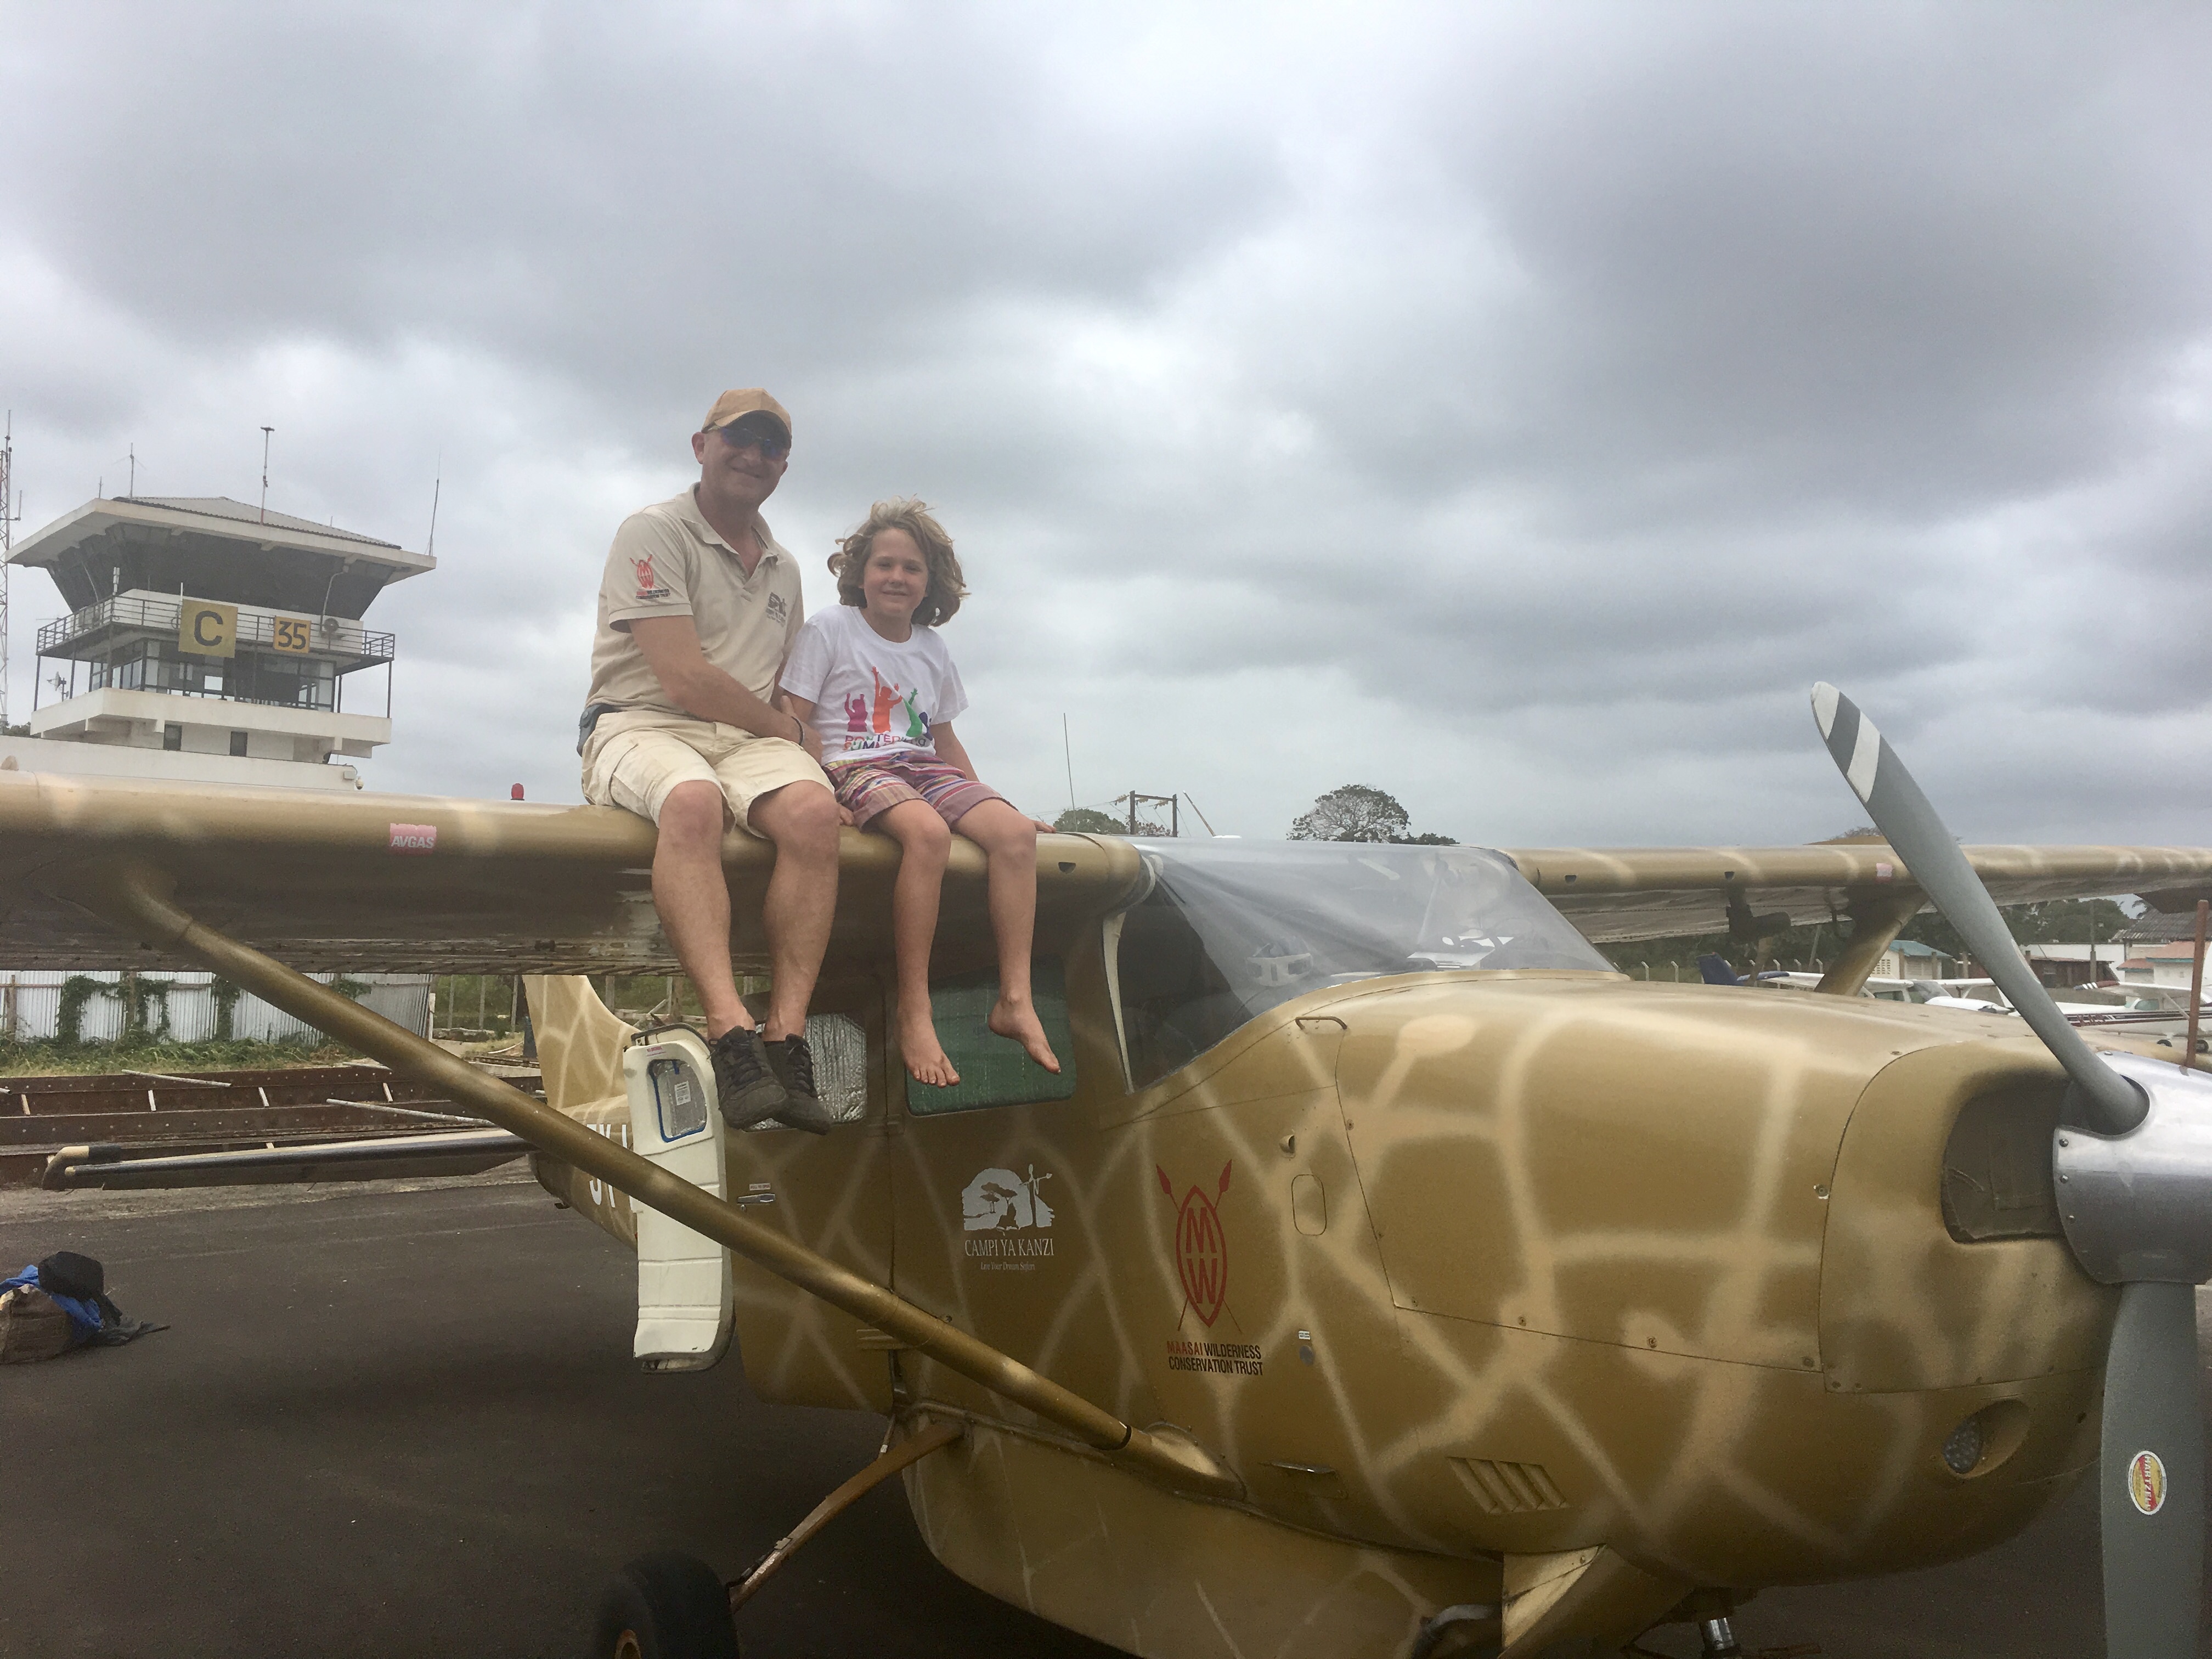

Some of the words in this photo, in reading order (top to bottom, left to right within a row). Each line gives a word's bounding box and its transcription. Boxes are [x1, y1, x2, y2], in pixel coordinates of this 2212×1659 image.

[194, 610, 223, 647] C
[278, 620, 307, 650] 35
[391, 836, 435, 849] AVGAS
[1186, 1207, 1217, 1254] M
[965, 1239, 998, 1256] CAMPI
[1000, 1239, 1016, 1256] YA
[1018, 1238, 1054, 1256] KANZI
[1186, 1258, 1217, 1304] W
[1166, 1340, 1203, 1356] MAASAI
[1204, 1342, 1261, 1359] WILDERNESS
[1169, 1356, 1234, 1374] CONSERVATION
[1234, 1360, 1263, 1376] TRUST
